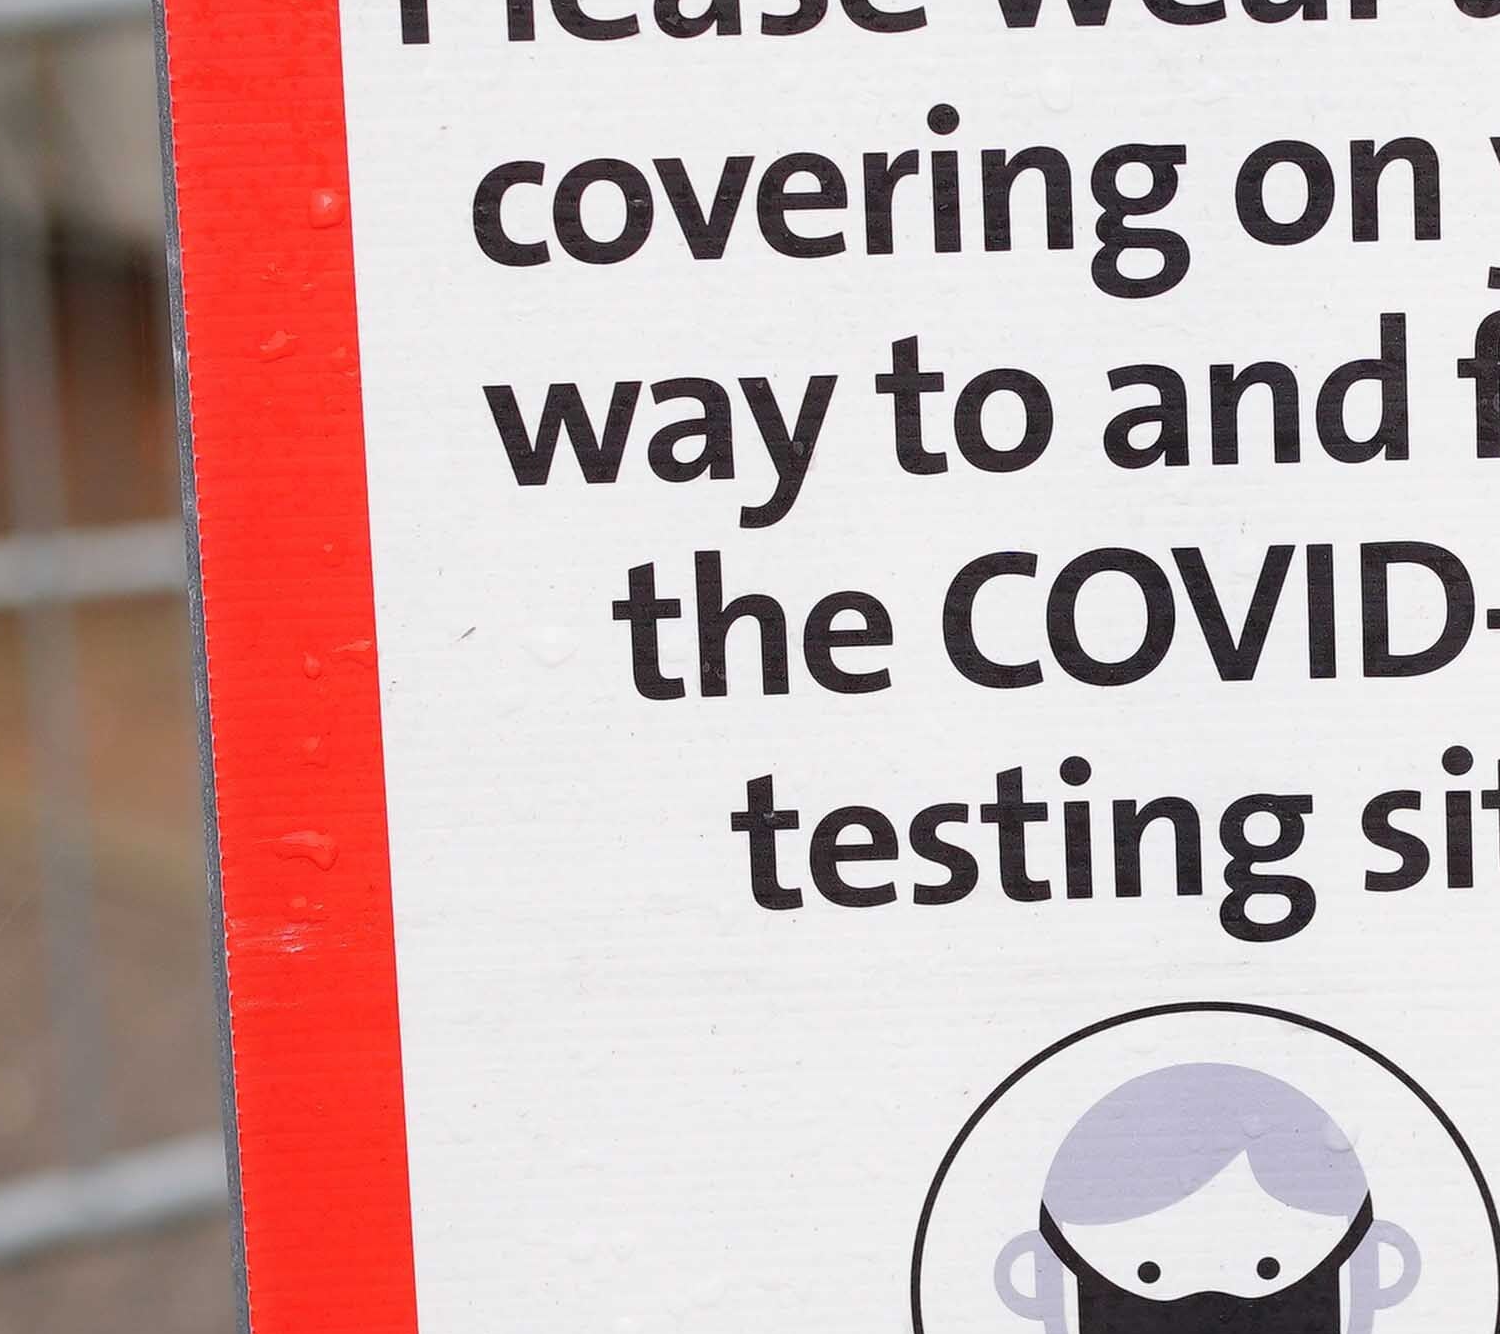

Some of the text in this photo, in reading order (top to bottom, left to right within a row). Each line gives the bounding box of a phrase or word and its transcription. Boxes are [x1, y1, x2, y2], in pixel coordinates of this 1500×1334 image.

[472, 103, 1191, 300] covering
[1234, 136, 1441, 246] on
[482, 374, 839, 529] way
[875, 335, 1054, 476] to
[1103, 312, 1410, 470] and
[611, 550, 894, 701] the
[730, 755, 1317, 943] testing
